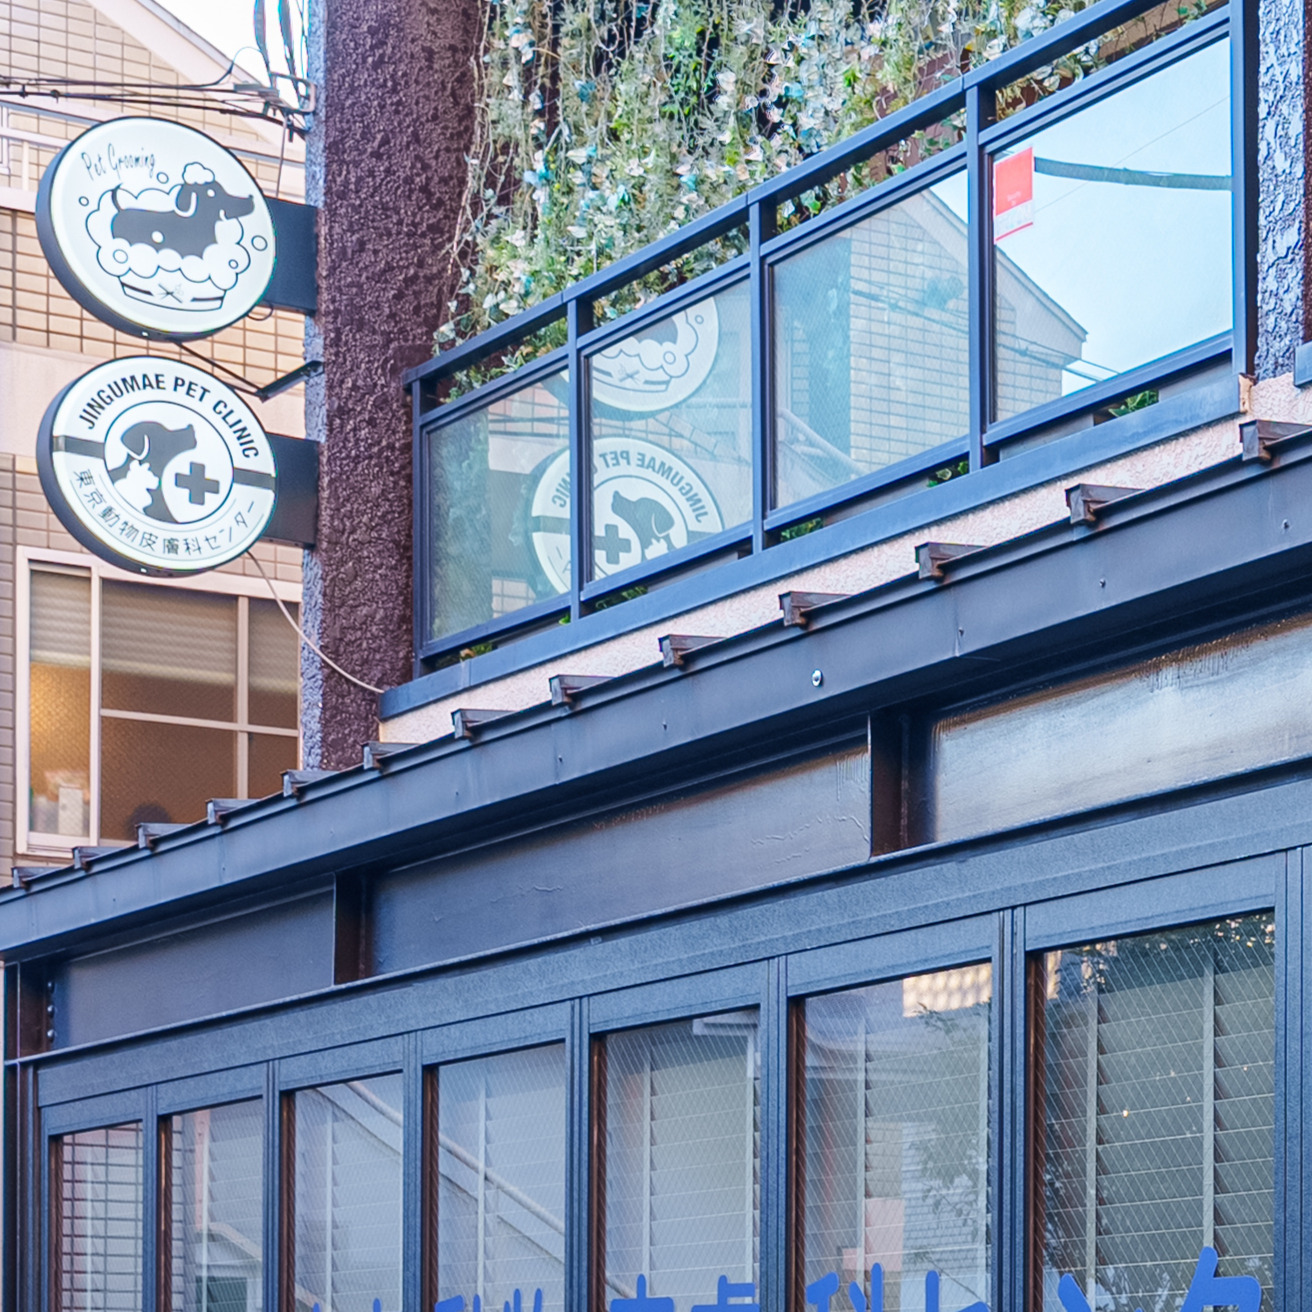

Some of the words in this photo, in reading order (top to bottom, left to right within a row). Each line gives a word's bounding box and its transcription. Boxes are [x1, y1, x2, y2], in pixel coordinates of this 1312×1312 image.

[81, 151, 106, 181] Pet
[107, 143, 155, 181] Grooming
[79, 373, 166, 430] JINGUMAE
[173, 376, 211, 402] PET
[212, 400, 260, 459] CLINIC
[73, 468, 255, 556] 東京動物皮膚科センター
